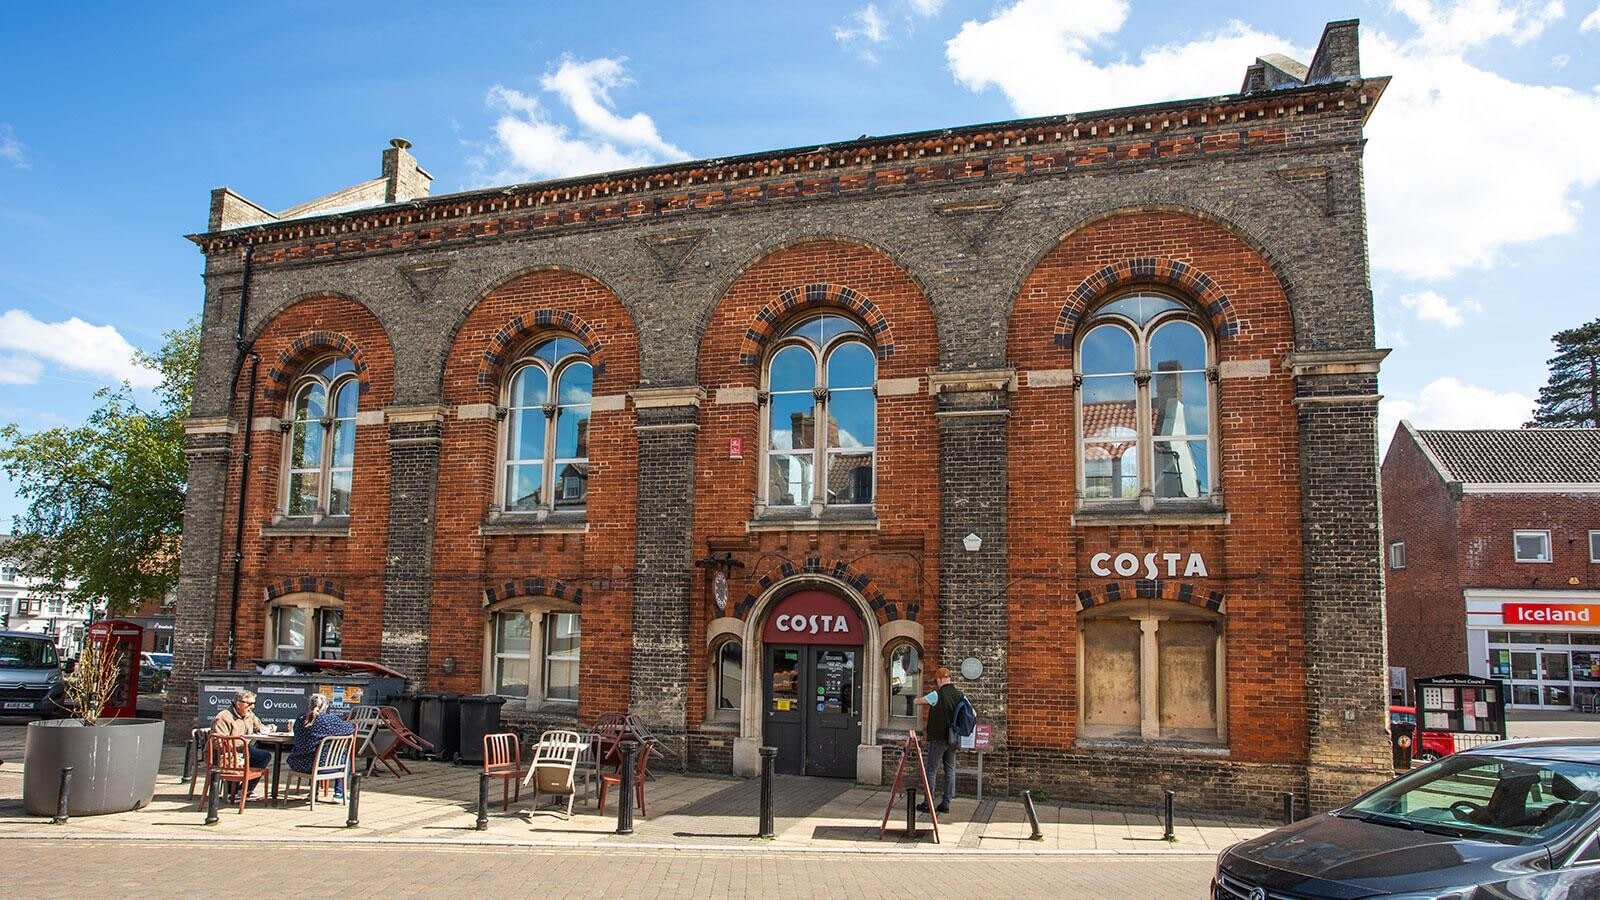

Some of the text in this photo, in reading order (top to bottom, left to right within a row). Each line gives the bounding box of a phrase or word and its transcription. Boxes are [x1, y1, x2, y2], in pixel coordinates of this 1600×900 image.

[1090, 552, 1208, 580] COSTA
[776, 614, 849, 634] COSTA
[1518, 607, 1590, 622] Iceland
